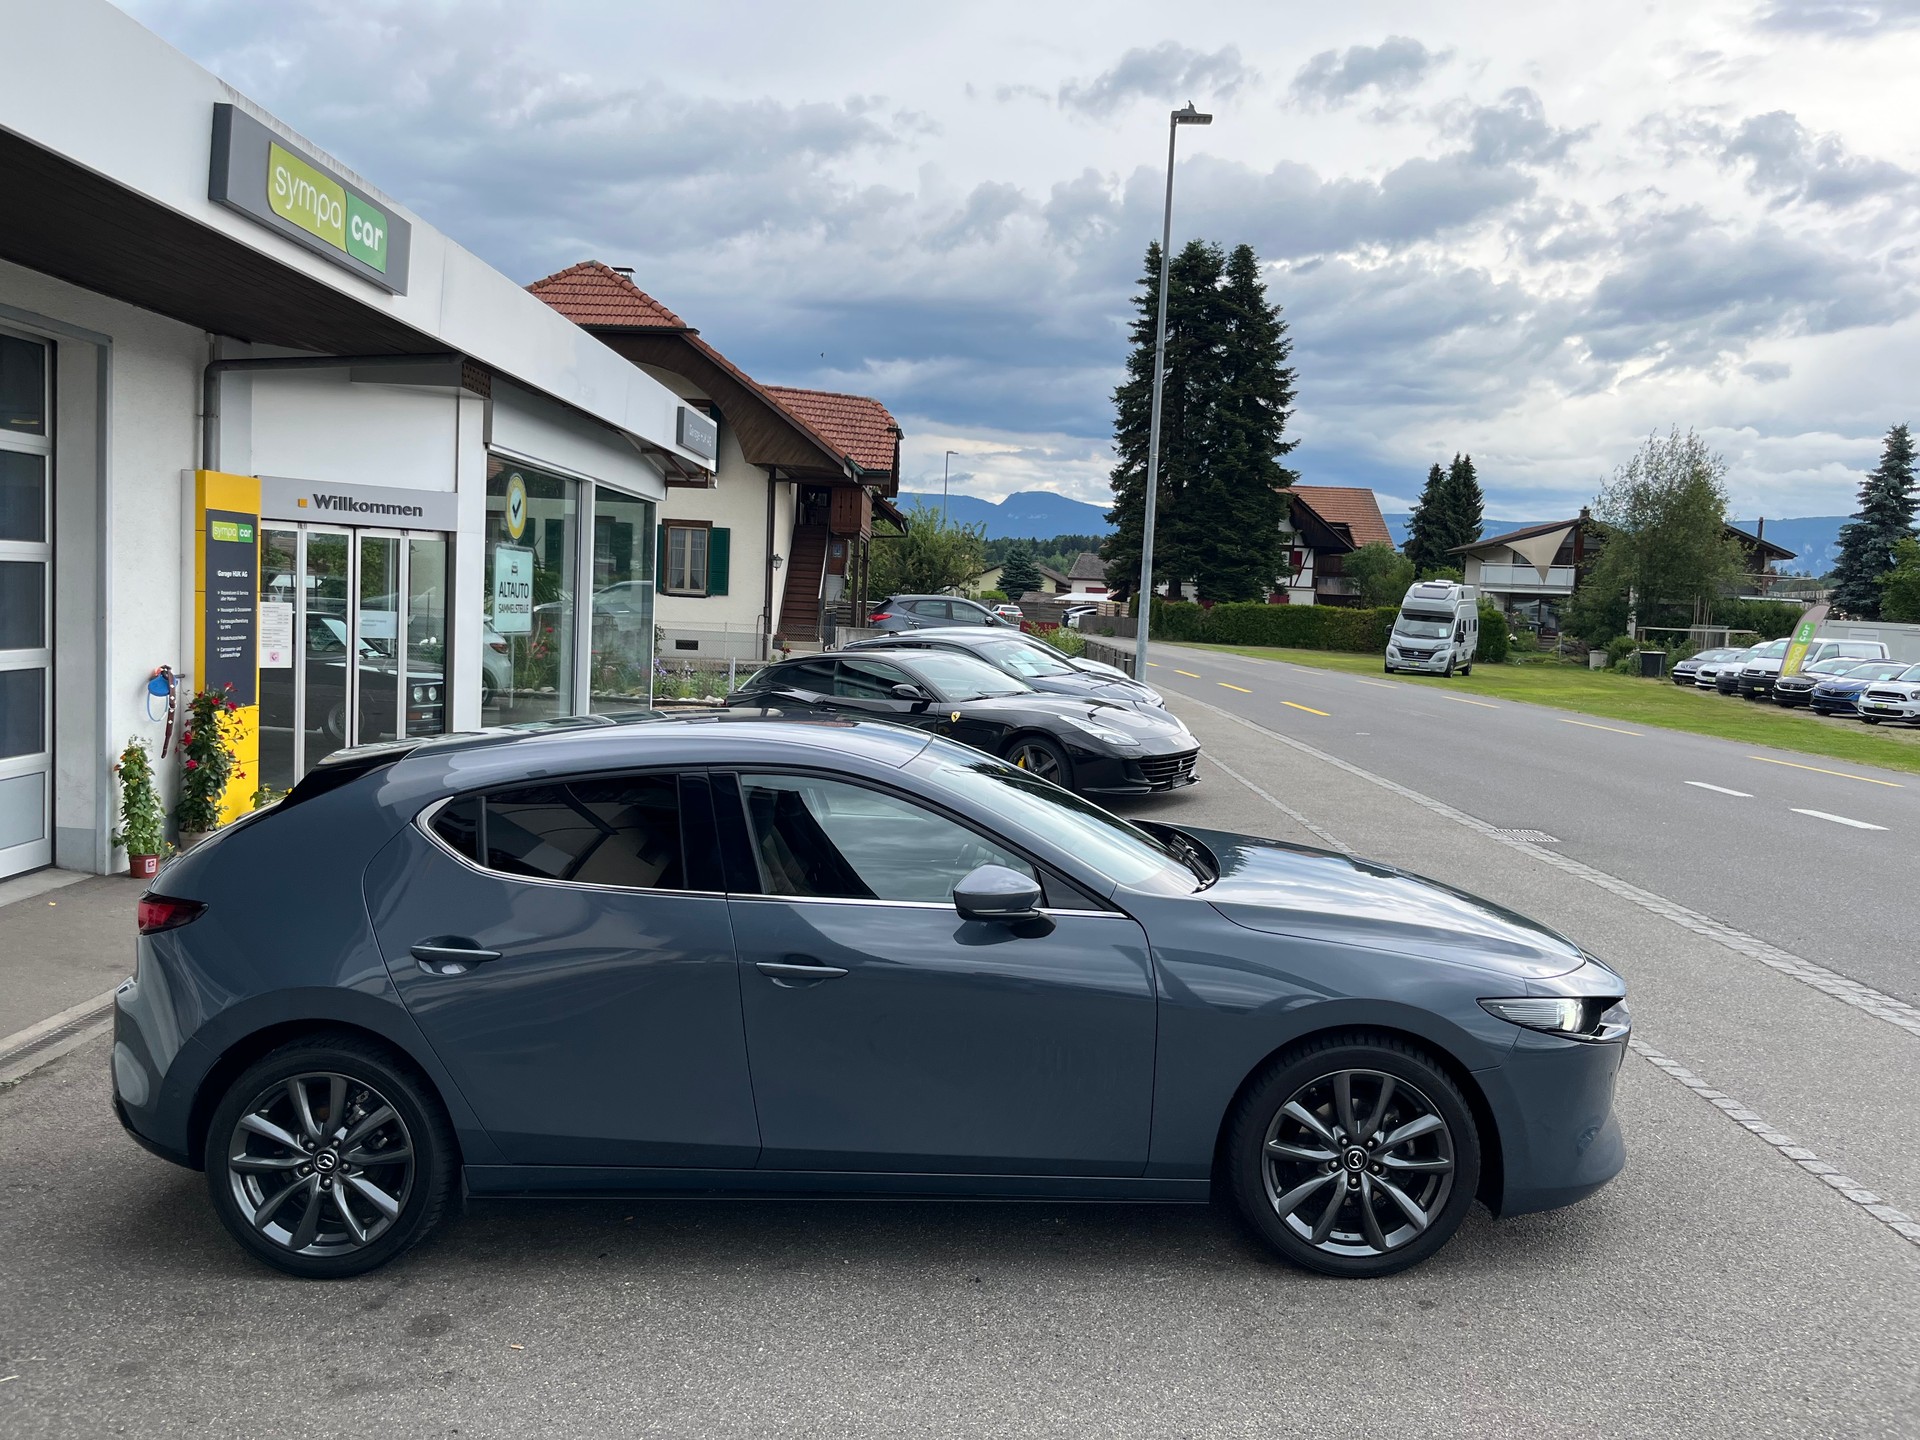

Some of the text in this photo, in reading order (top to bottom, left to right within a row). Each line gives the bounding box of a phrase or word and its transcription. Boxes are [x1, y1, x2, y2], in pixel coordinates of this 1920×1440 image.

[275, 166, 384, 251] sympa car
[312, 493, 424, 518] Willkommen
[214, 526, 252, 539] sympa car
[498, 581, 530, 599] ALTAUTO
[498, 603, 530, 614] SAMMELSTELLE
[1799, 624, 1811, 642] car
